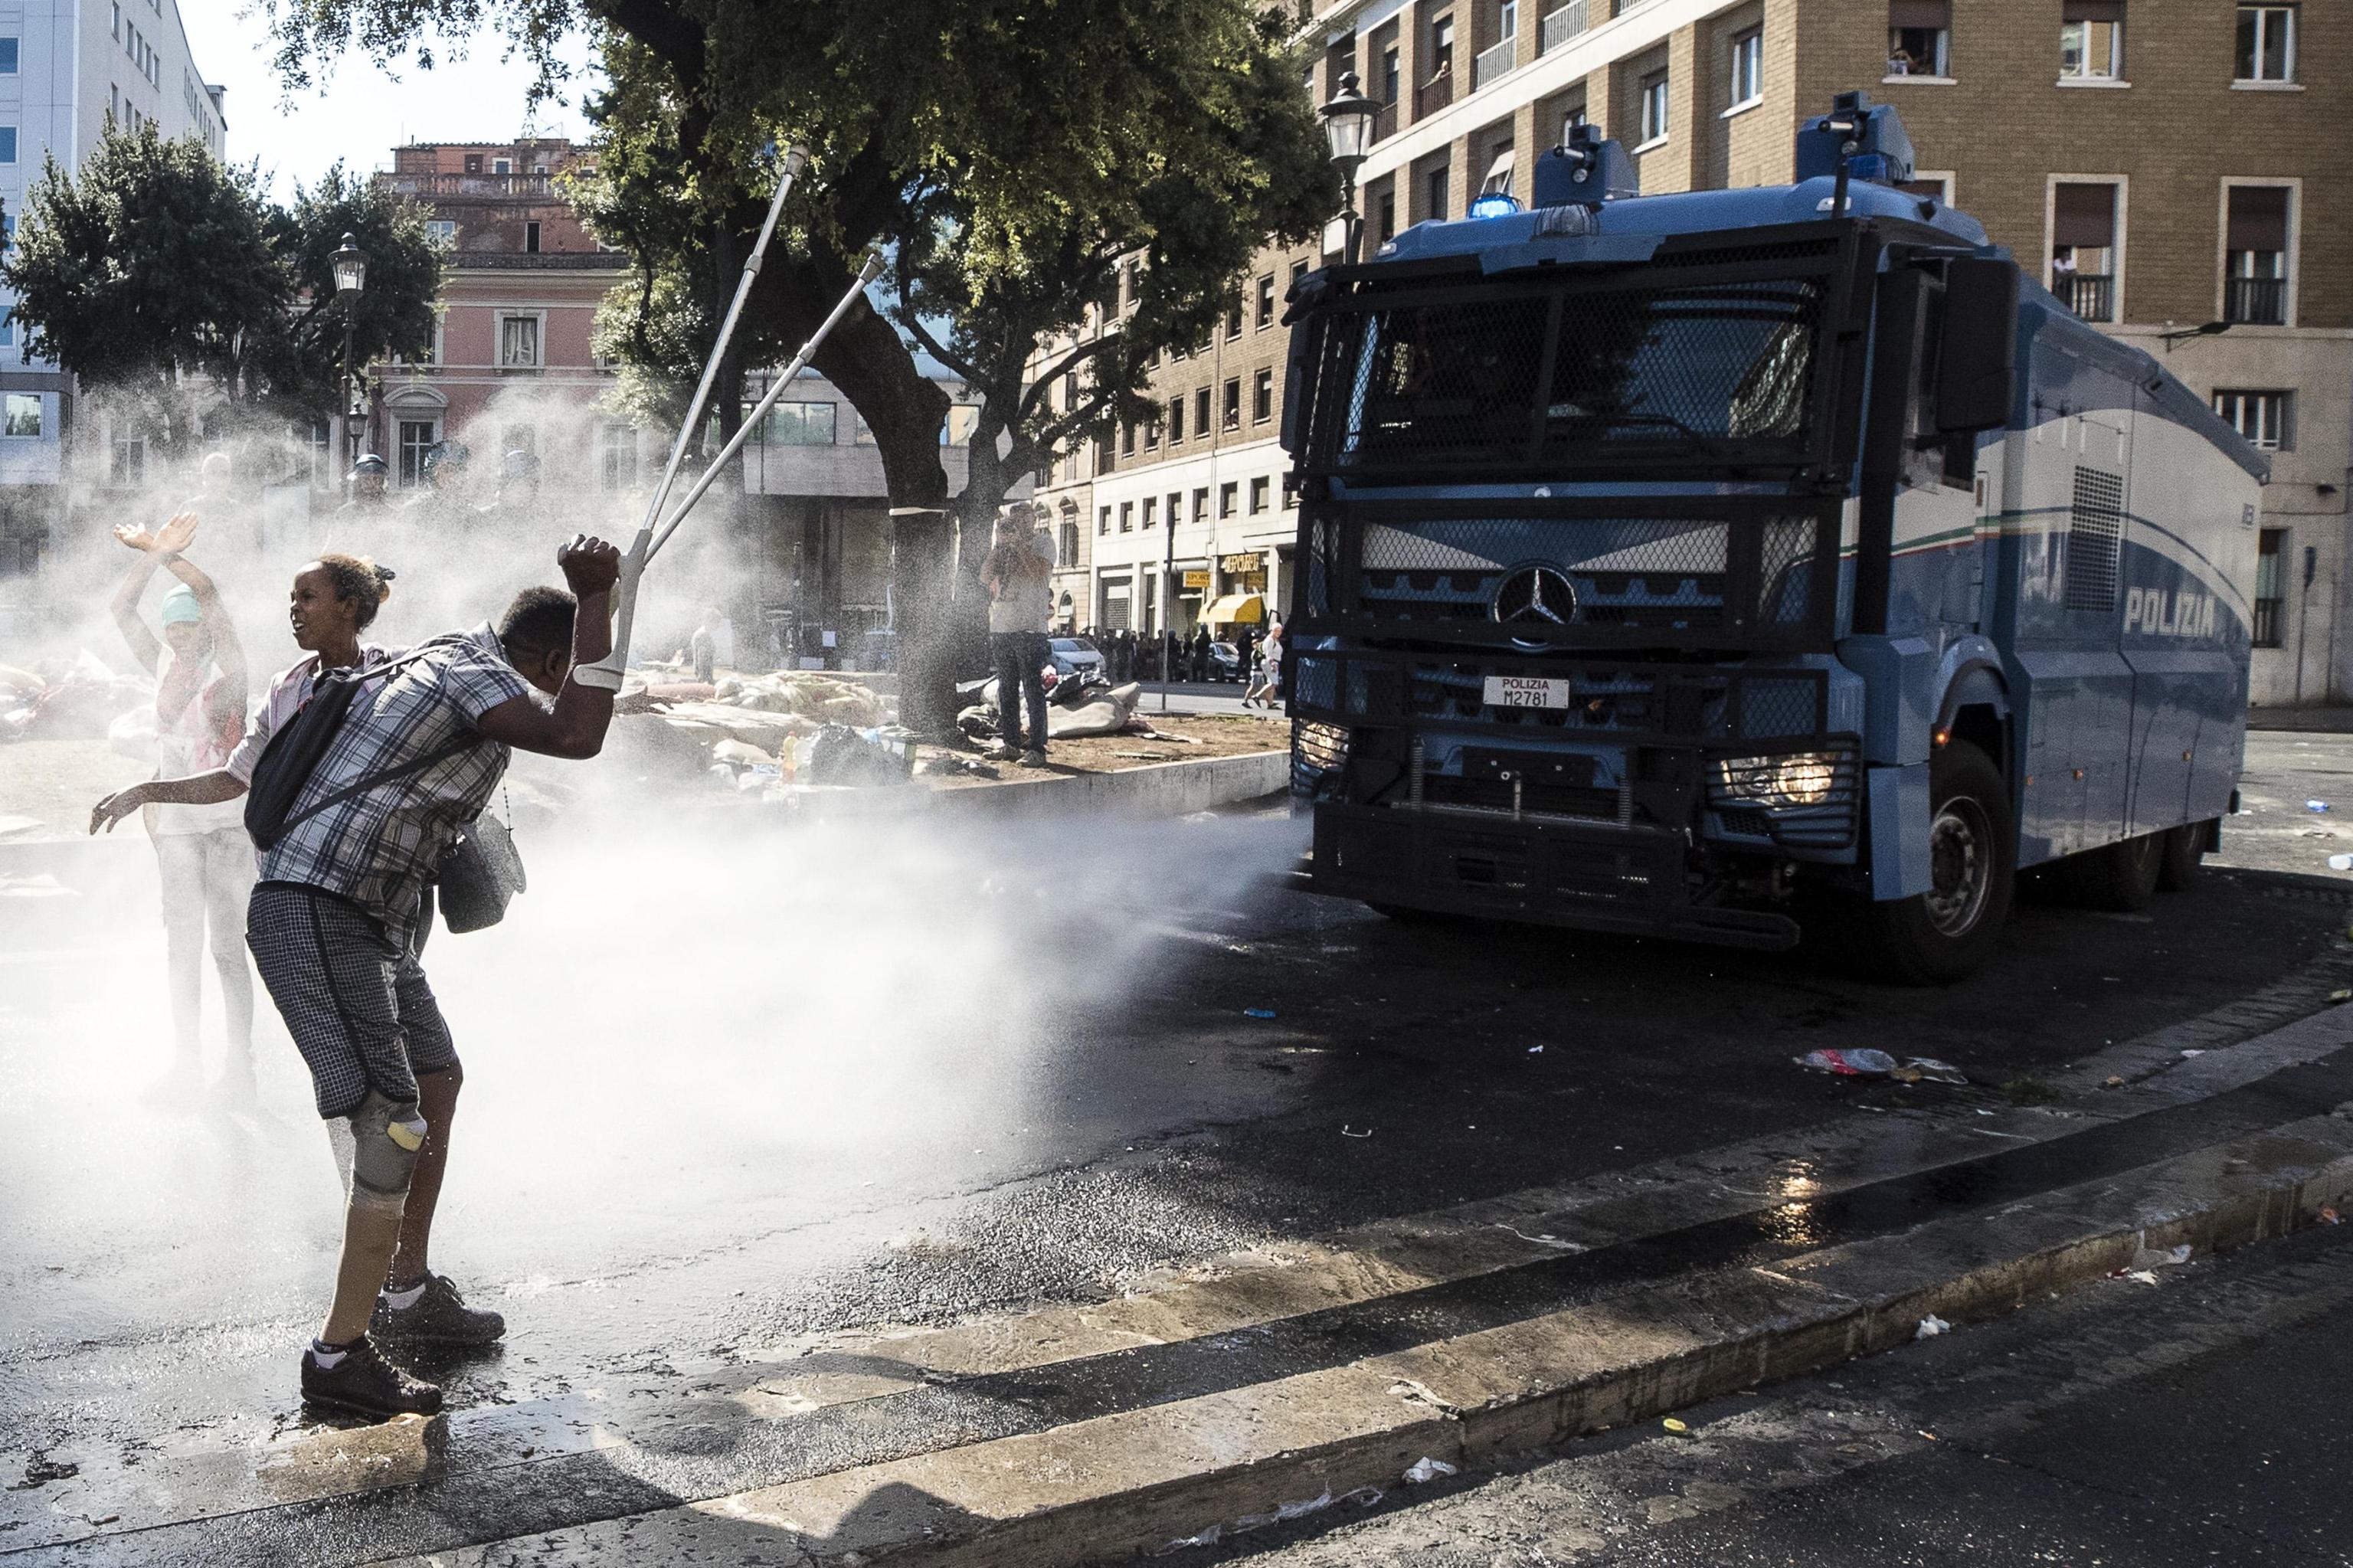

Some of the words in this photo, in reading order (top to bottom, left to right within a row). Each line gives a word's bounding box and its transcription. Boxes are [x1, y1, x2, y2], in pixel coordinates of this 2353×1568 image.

[1222, 553, 1259, 573] SPORT
[2124, 586, 2215, 637] POLIZIA
[1502, 679, 1549, 690] POLIZIA
[1504, 691, 1547, 705] M2781
